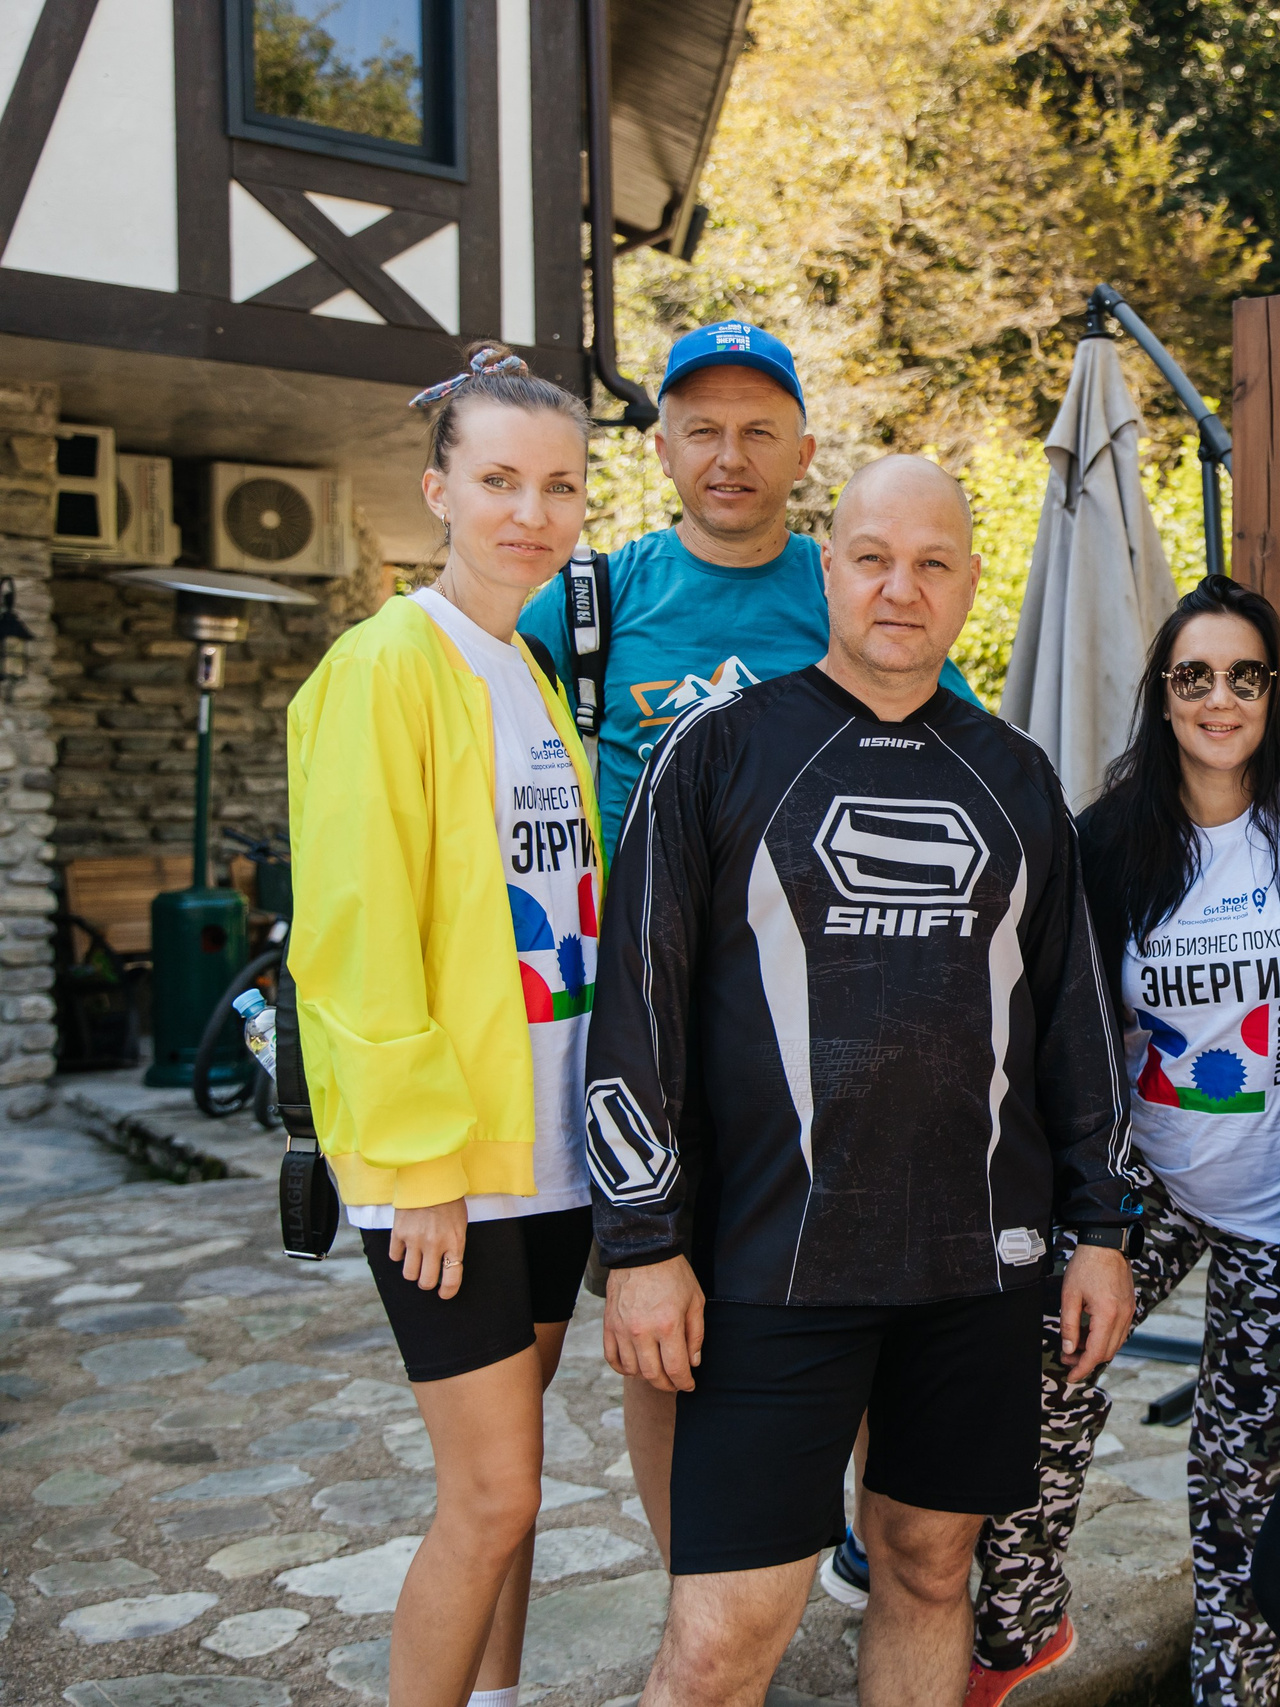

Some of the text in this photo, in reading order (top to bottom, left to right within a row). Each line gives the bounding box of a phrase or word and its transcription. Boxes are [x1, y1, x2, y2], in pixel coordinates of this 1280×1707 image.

[1222, 893, 1248, 905] мой
[1203, 902, 1249, 916] бизнес
[823, 906, 979, 937] SHIFT
[1177, 912, 1249, 926] Краснодарский край
[1175, 933, 1238, 957] БИЗНЕС
